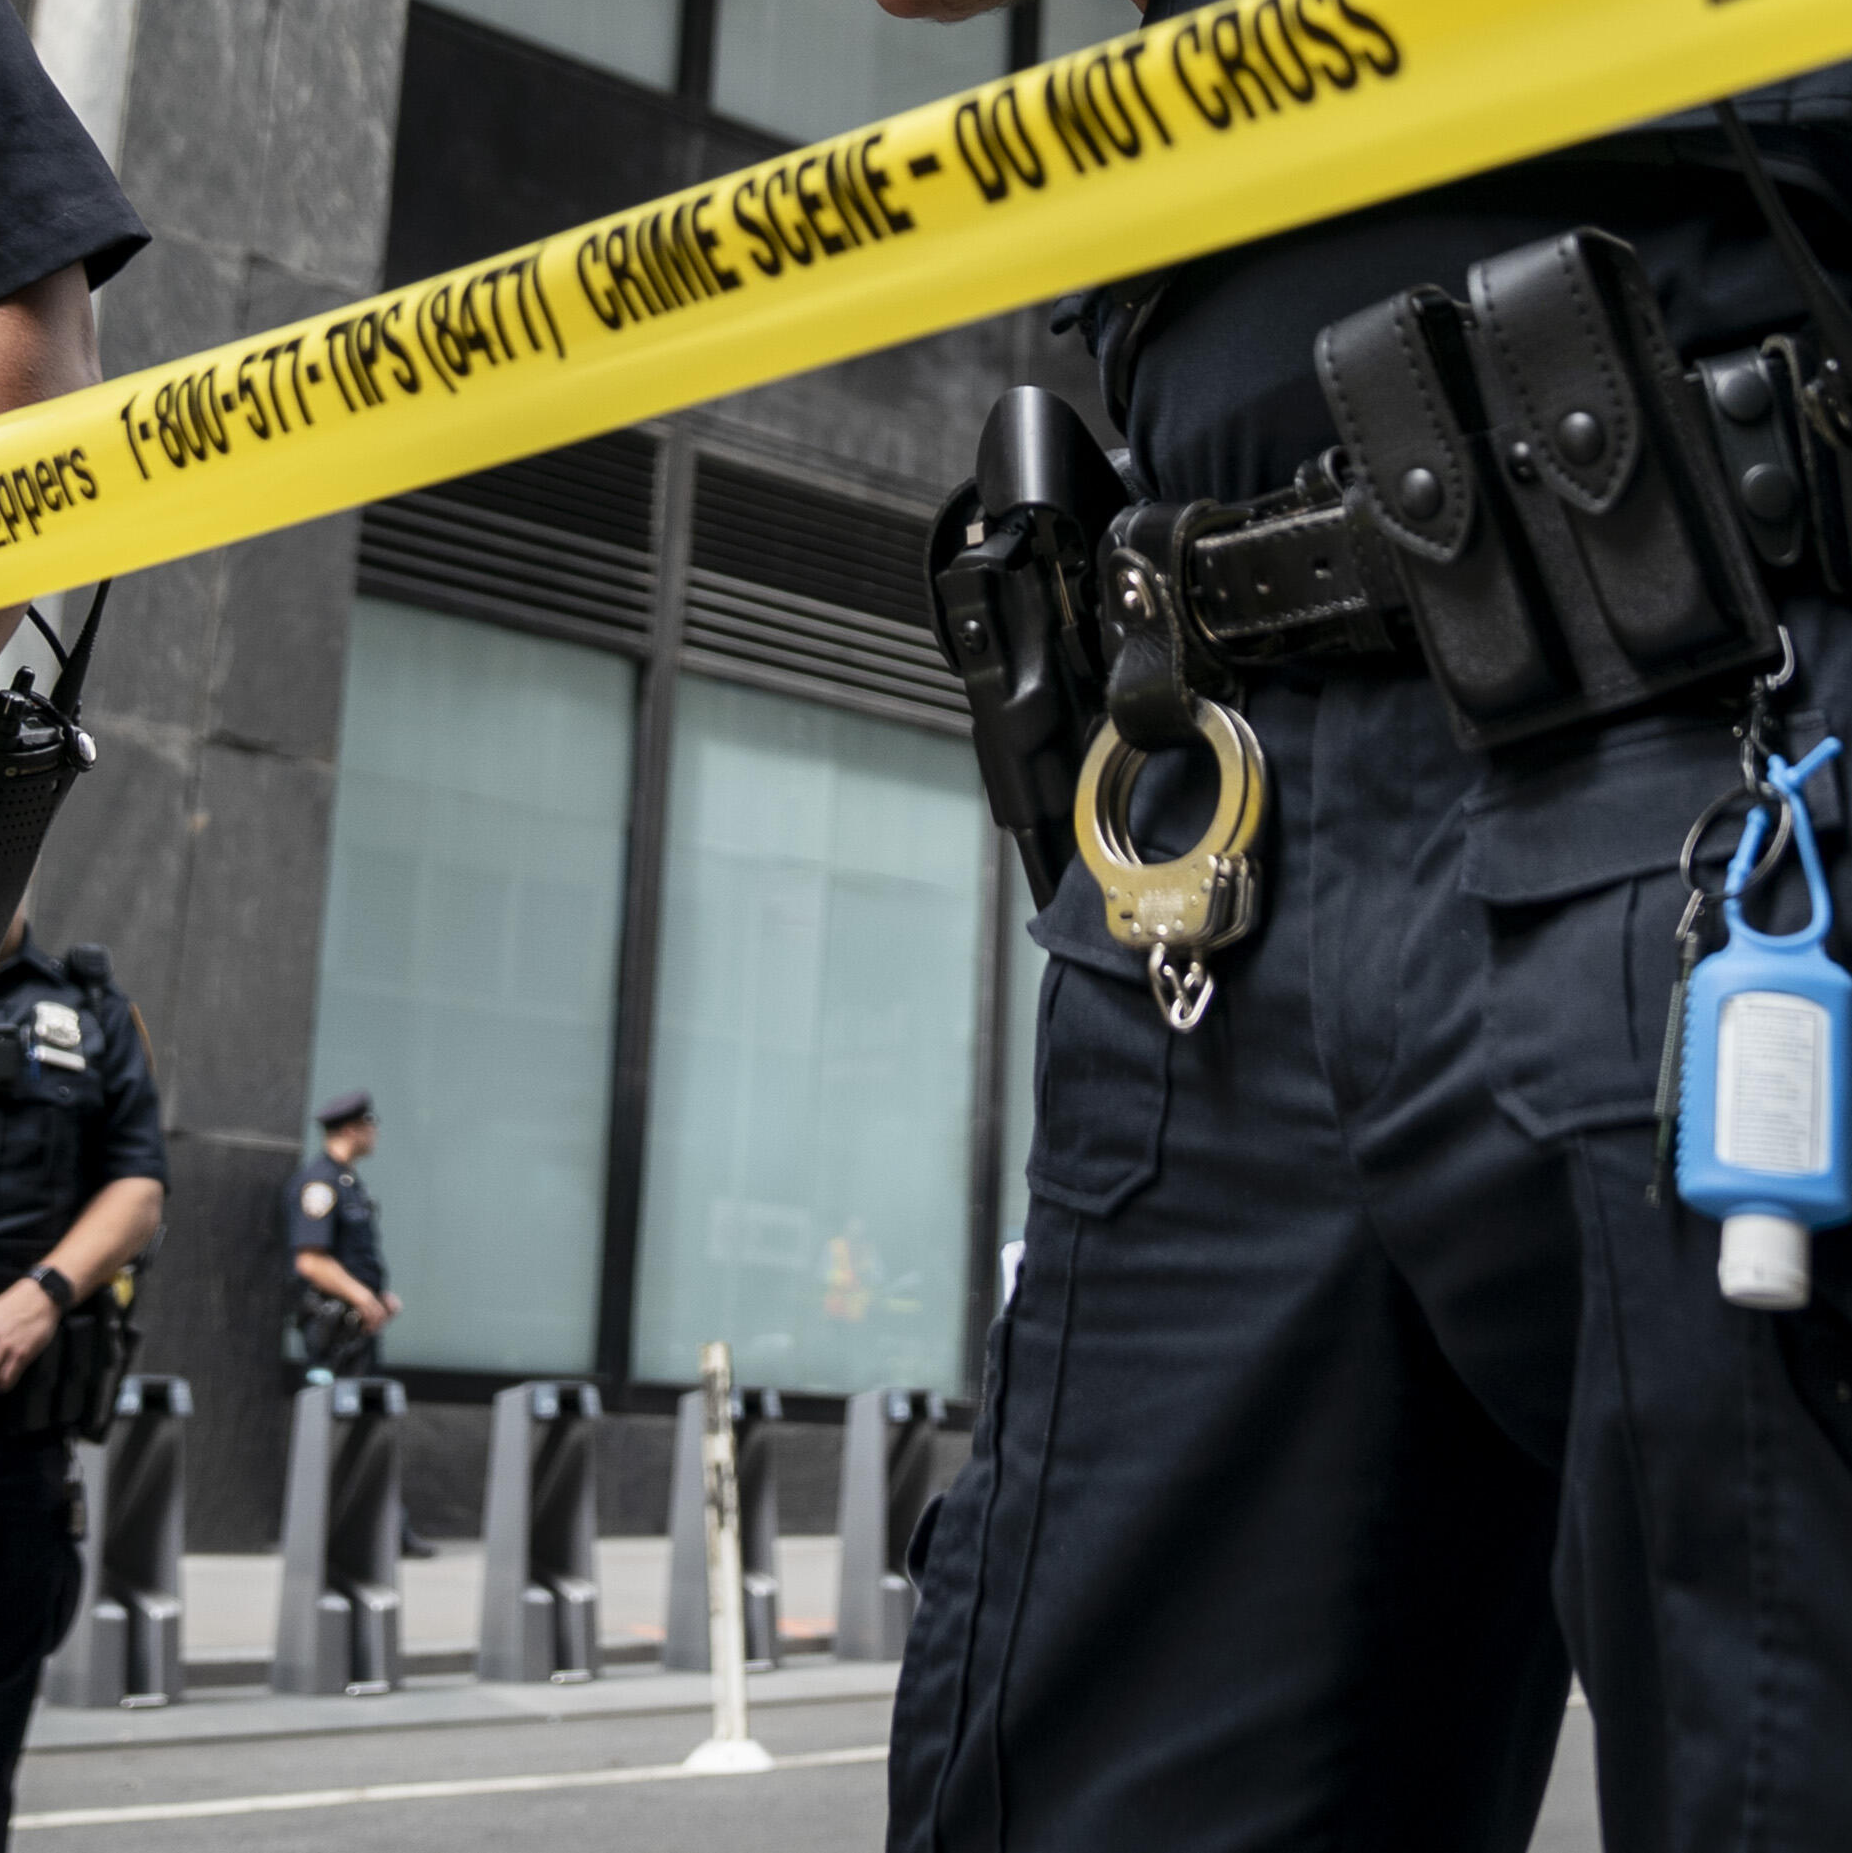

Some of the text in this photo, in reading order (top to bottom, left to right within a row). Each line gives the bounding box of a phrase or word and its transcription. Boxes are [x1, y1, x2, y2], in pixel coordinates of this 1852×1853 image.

[120, 301, 420, 481] 1-800-577-TIPS
[415, 242, 568, 395] (8477)
[575, 192, 745, 331] CRIME
[731, 132, 916, 278] SCENE
[953, 84, 1049, 205] DO
[1043, 42, 1175, 176] NOT
